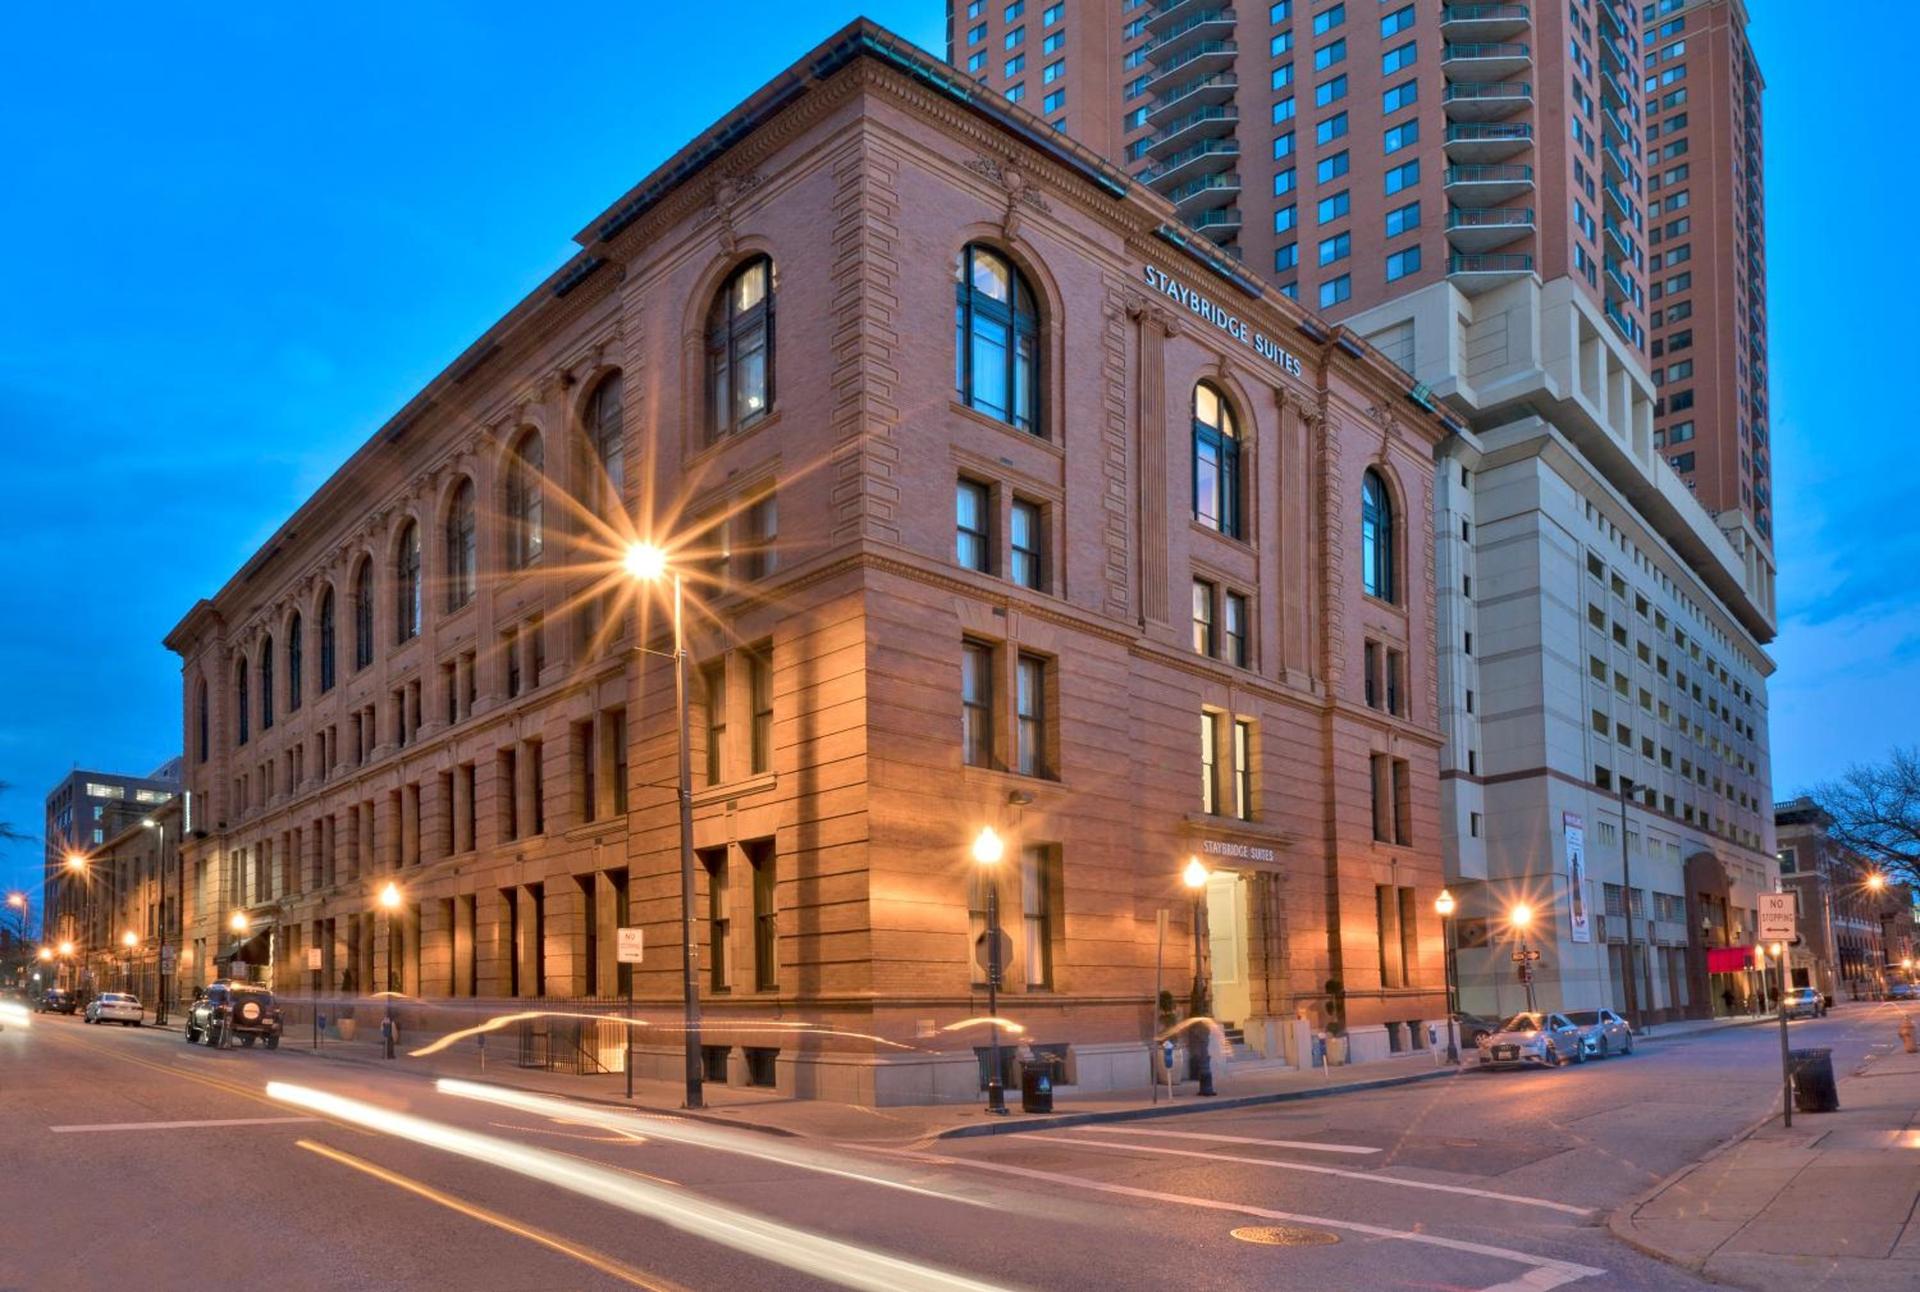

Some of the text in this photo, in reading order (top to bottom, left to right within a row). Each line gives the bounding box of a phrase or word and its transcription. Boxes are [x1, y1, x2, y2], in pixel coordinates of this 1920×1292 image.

[1145, 264, 1302, 377] STAYBRIDGE SUITES
[1203, 840, 1274, 861] STAYBRIDGE SUITES
[1769, 899, 1784, 909] NO
